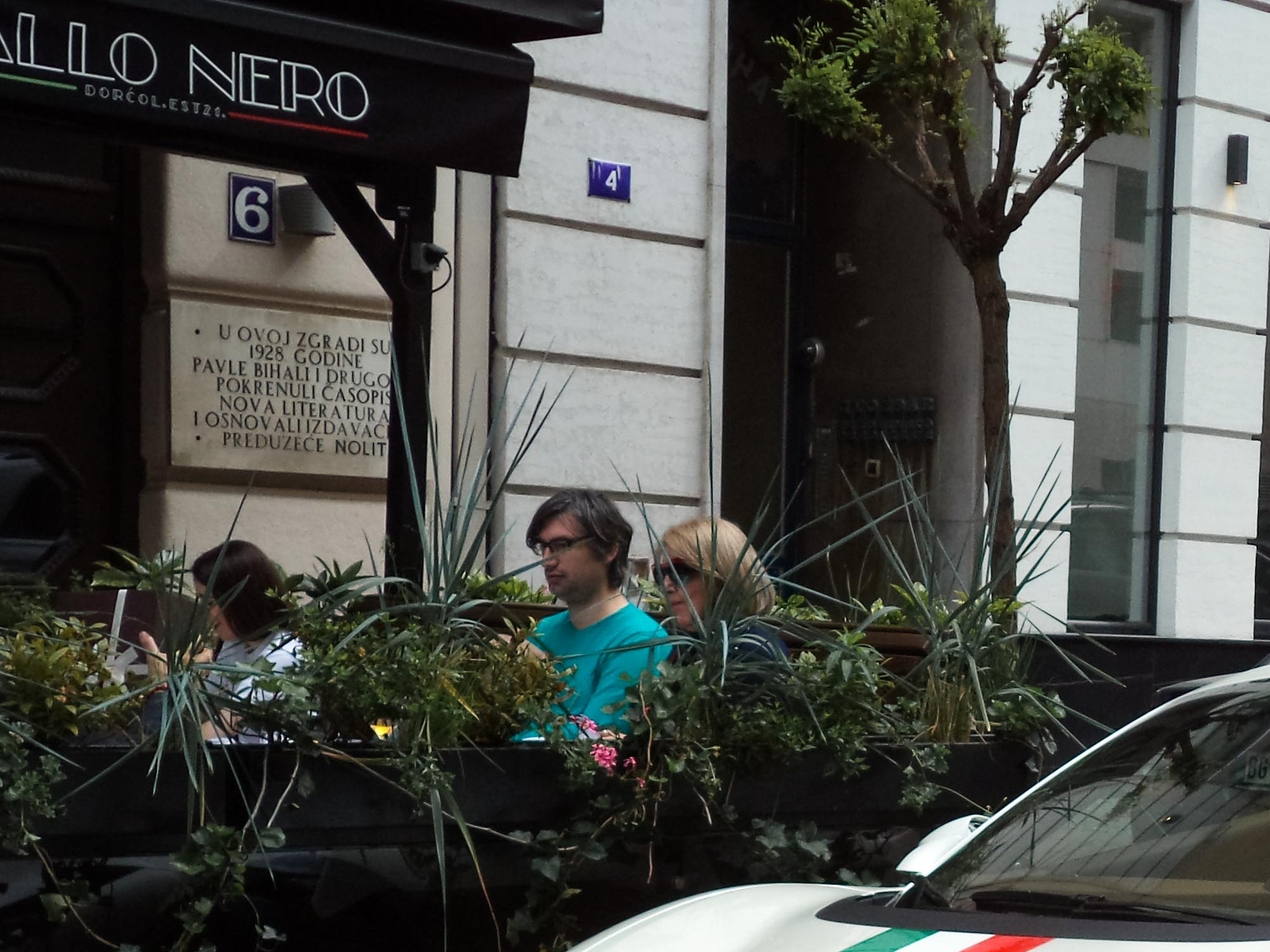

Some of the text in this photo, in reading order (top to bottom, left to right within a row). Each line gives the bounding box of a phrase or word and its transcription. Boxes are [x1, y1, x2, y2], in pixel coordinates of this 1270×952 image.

[189, 44, 369, 121] NERO
[605, 170, 617, 191] 4
[234, 186, 270, 233] 6
[219, 324, 390, 355] U OVOJ ZGRADI SU
[193, 356, 248, 377] PAVLE
[254, 362, 310, 382] BIHALI
[315, 367, 320, 383] I
[250, 344, 363, 369] 1928 GODINE
[216, 377, 316, 400] POKRENULI
[194, 411, 198, 426] I
[205, 411, 301, 434] OSNOVALI
[220, 395, 389, 424] NOVA LITERATURA
[223, 431, 387, 457] PREDUZEĆE NOLIT
